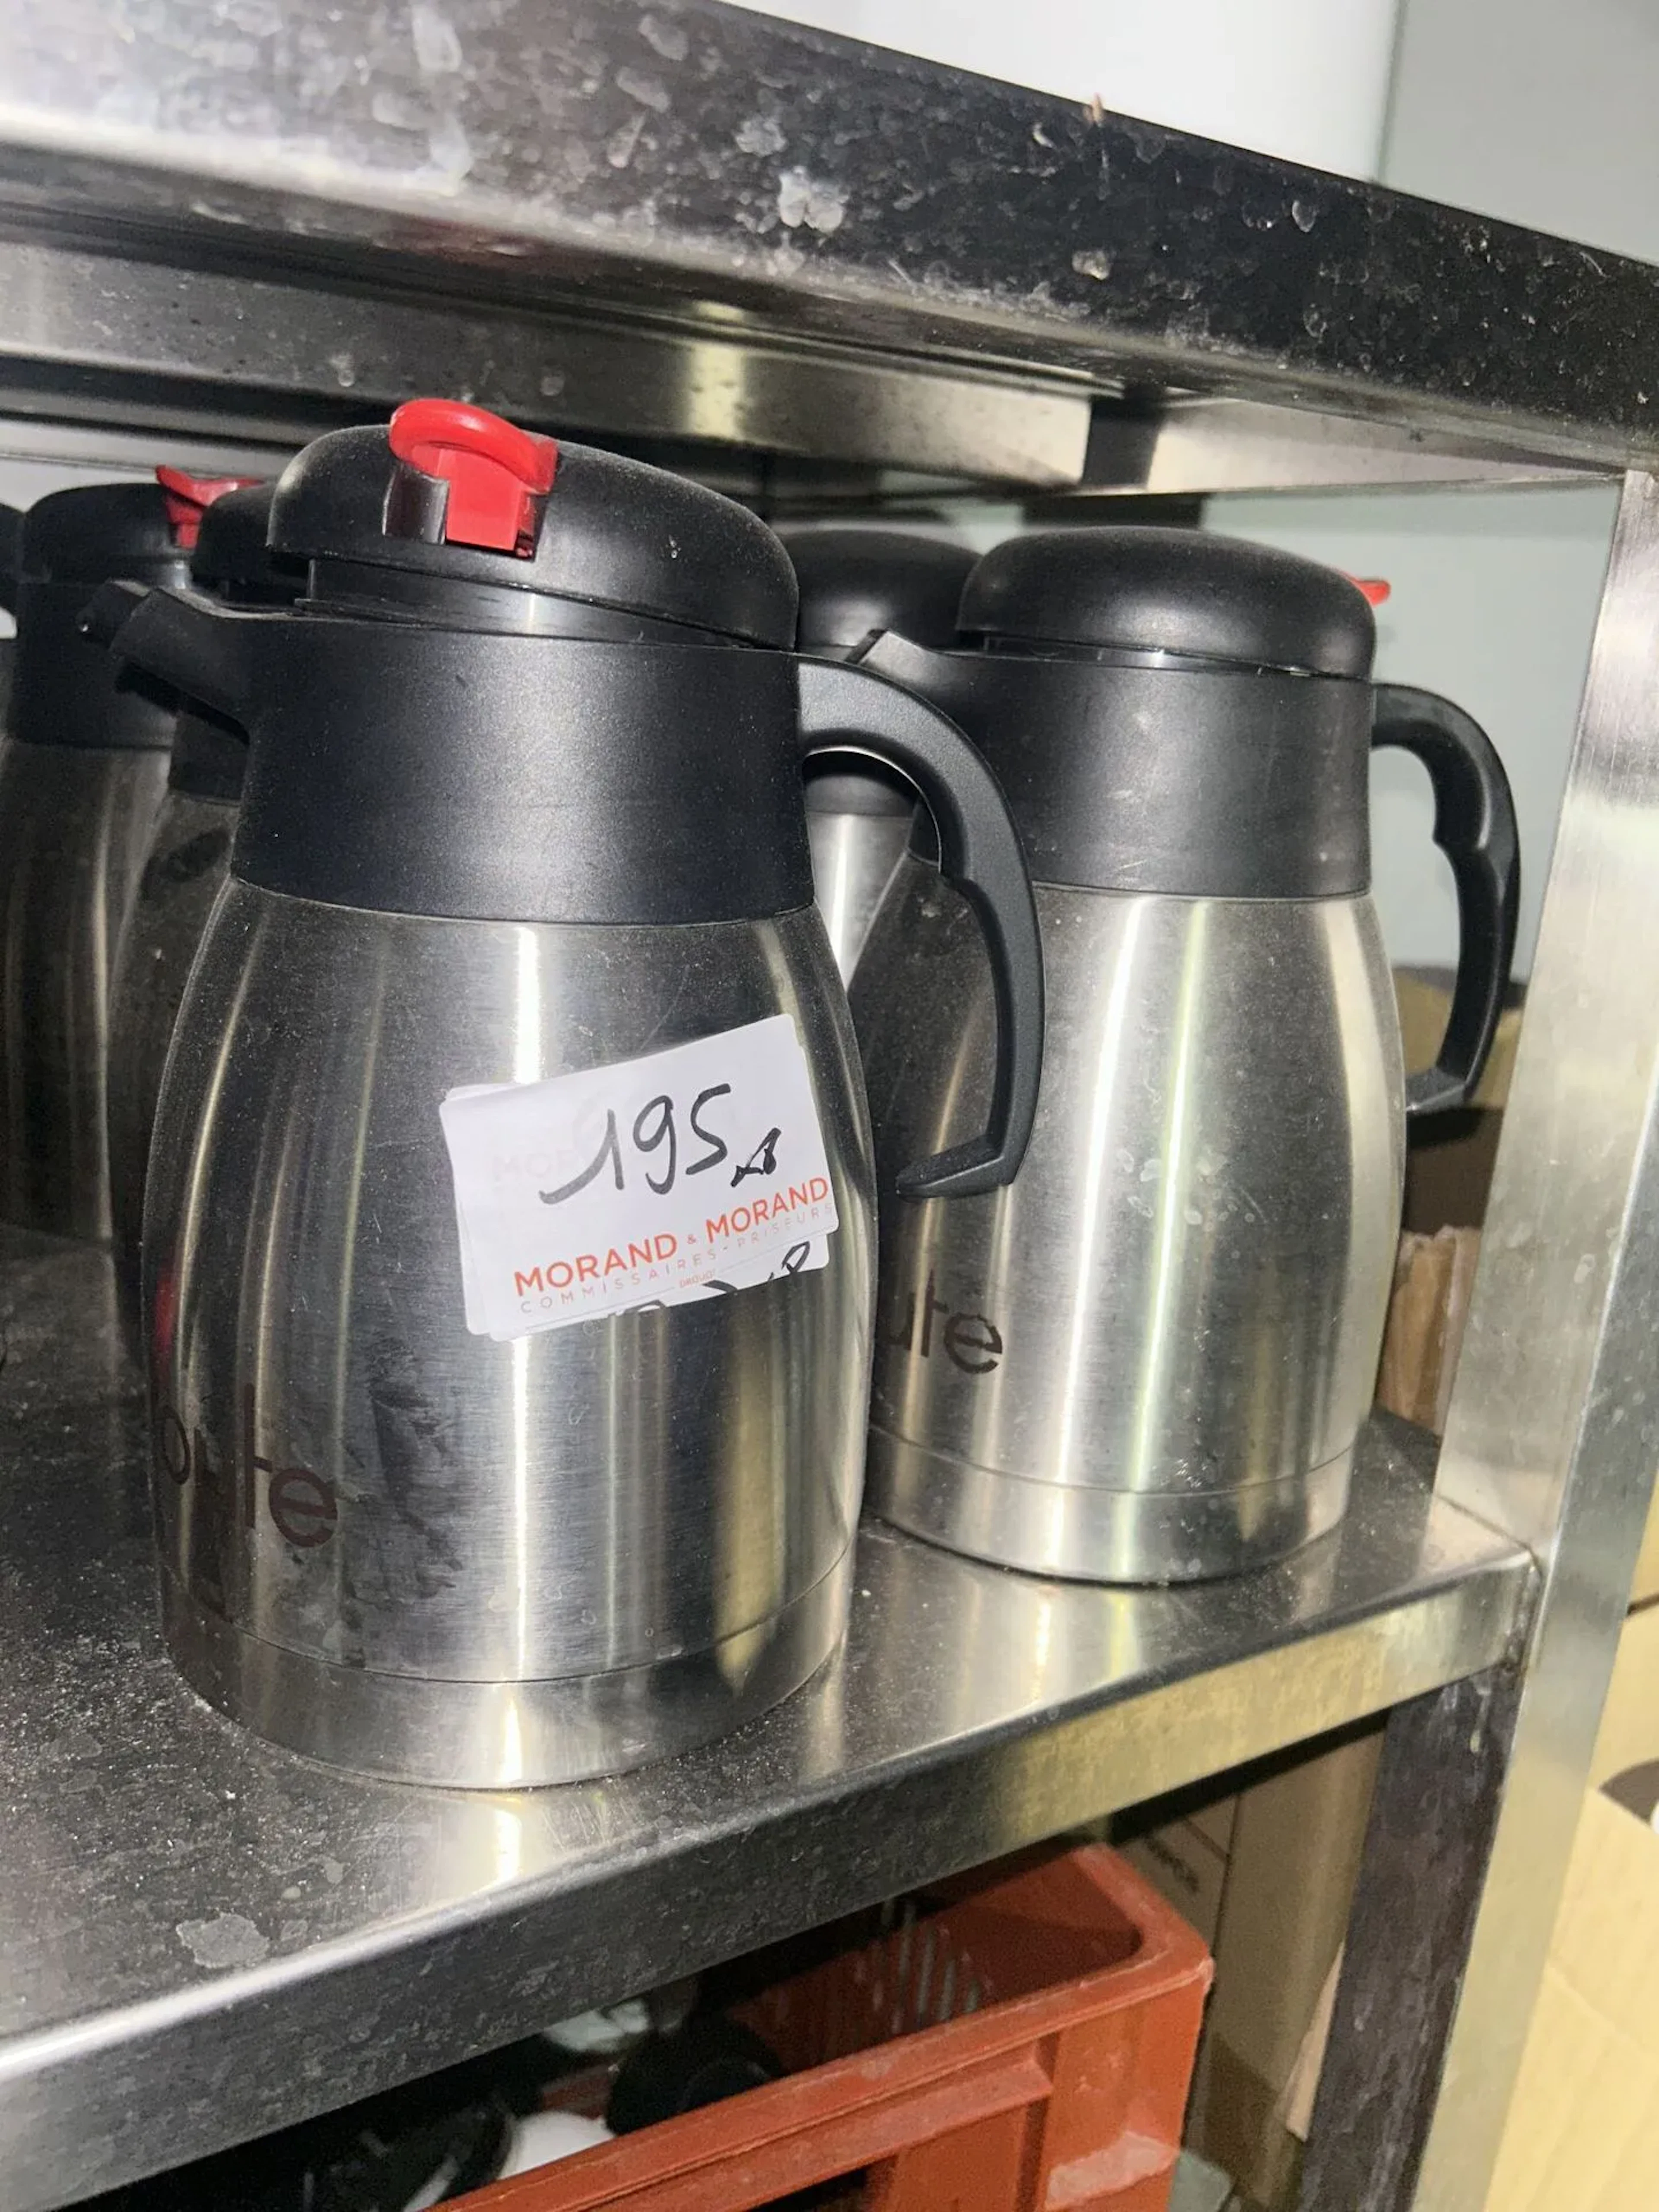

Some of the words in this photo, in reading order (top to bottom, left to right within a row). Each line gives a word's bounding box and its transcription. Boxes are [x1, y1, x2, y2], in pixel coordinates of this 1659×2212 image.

[514, 1233, 678, 1297] MORAND
[686, 1234, 697, 1245] &
[706, 1176, 829, 1244] MORAND
